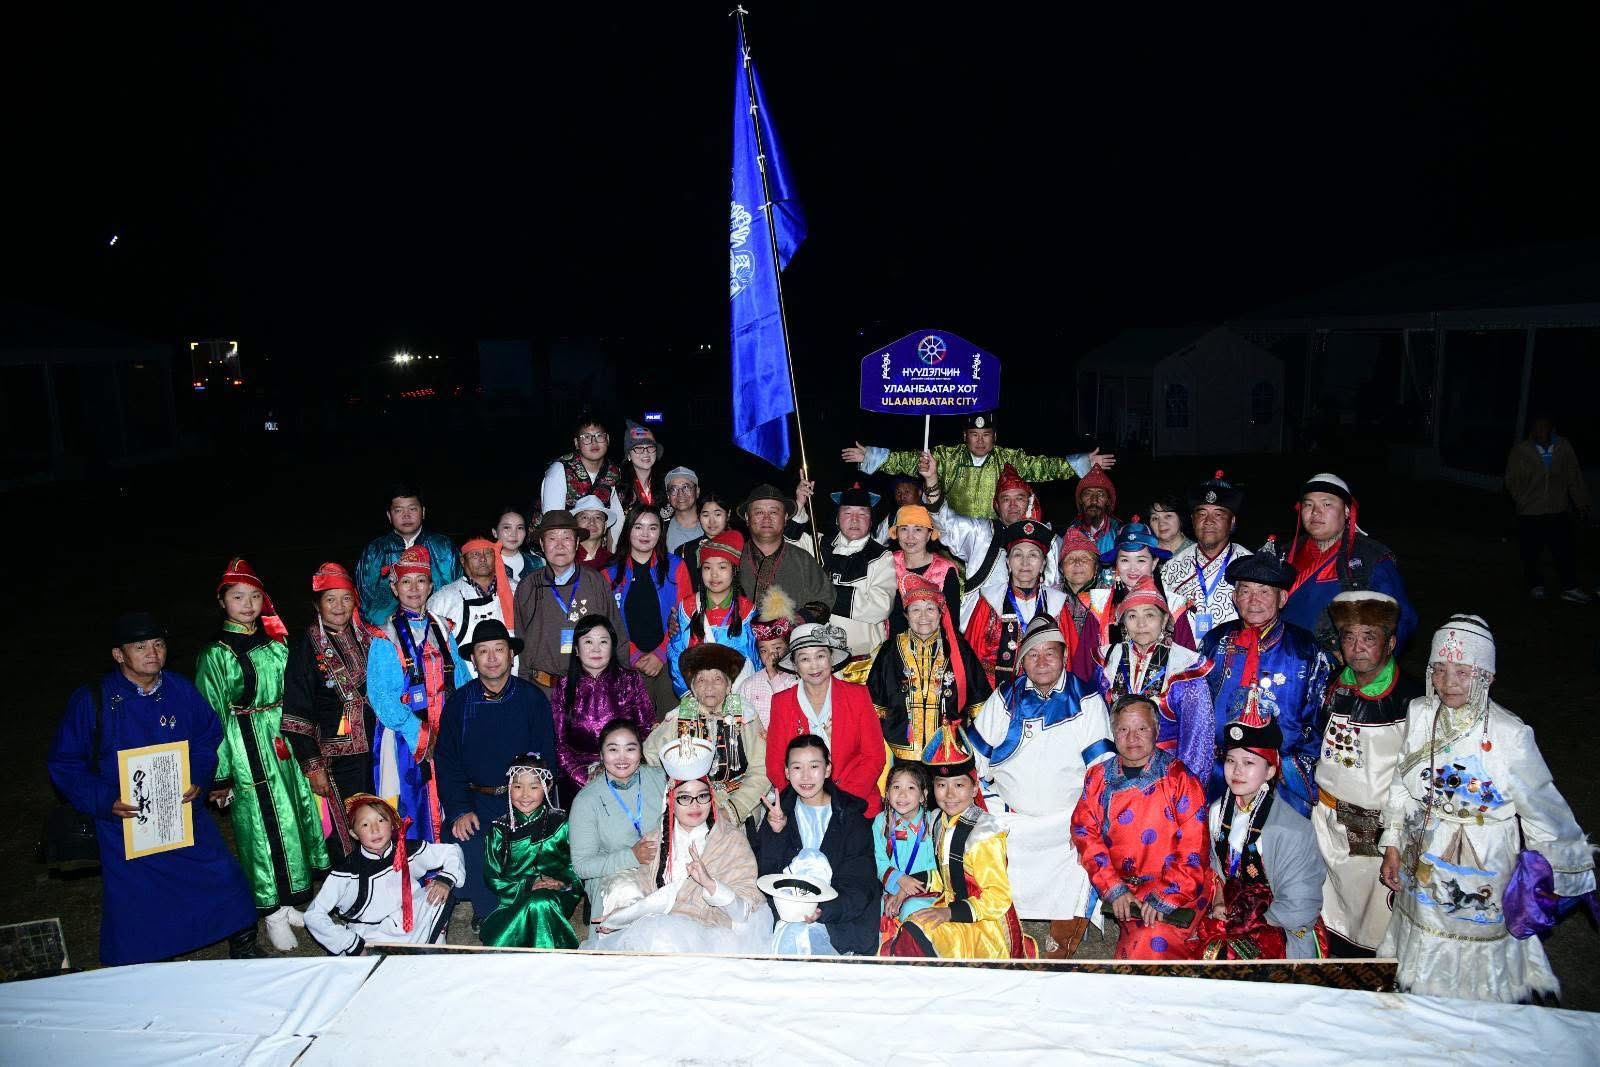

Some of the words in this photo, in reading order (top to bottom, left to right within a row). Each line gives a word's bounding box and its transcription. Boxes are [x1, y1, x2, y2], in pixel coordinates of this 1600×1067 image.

[884, 385, 955, 393] УЛААНБААТАР
[957, 385, 978, 393] ХОТ
[882, 397, 954, 406] ULAANBAATAR
[956, 397, 978, 405] CITY
